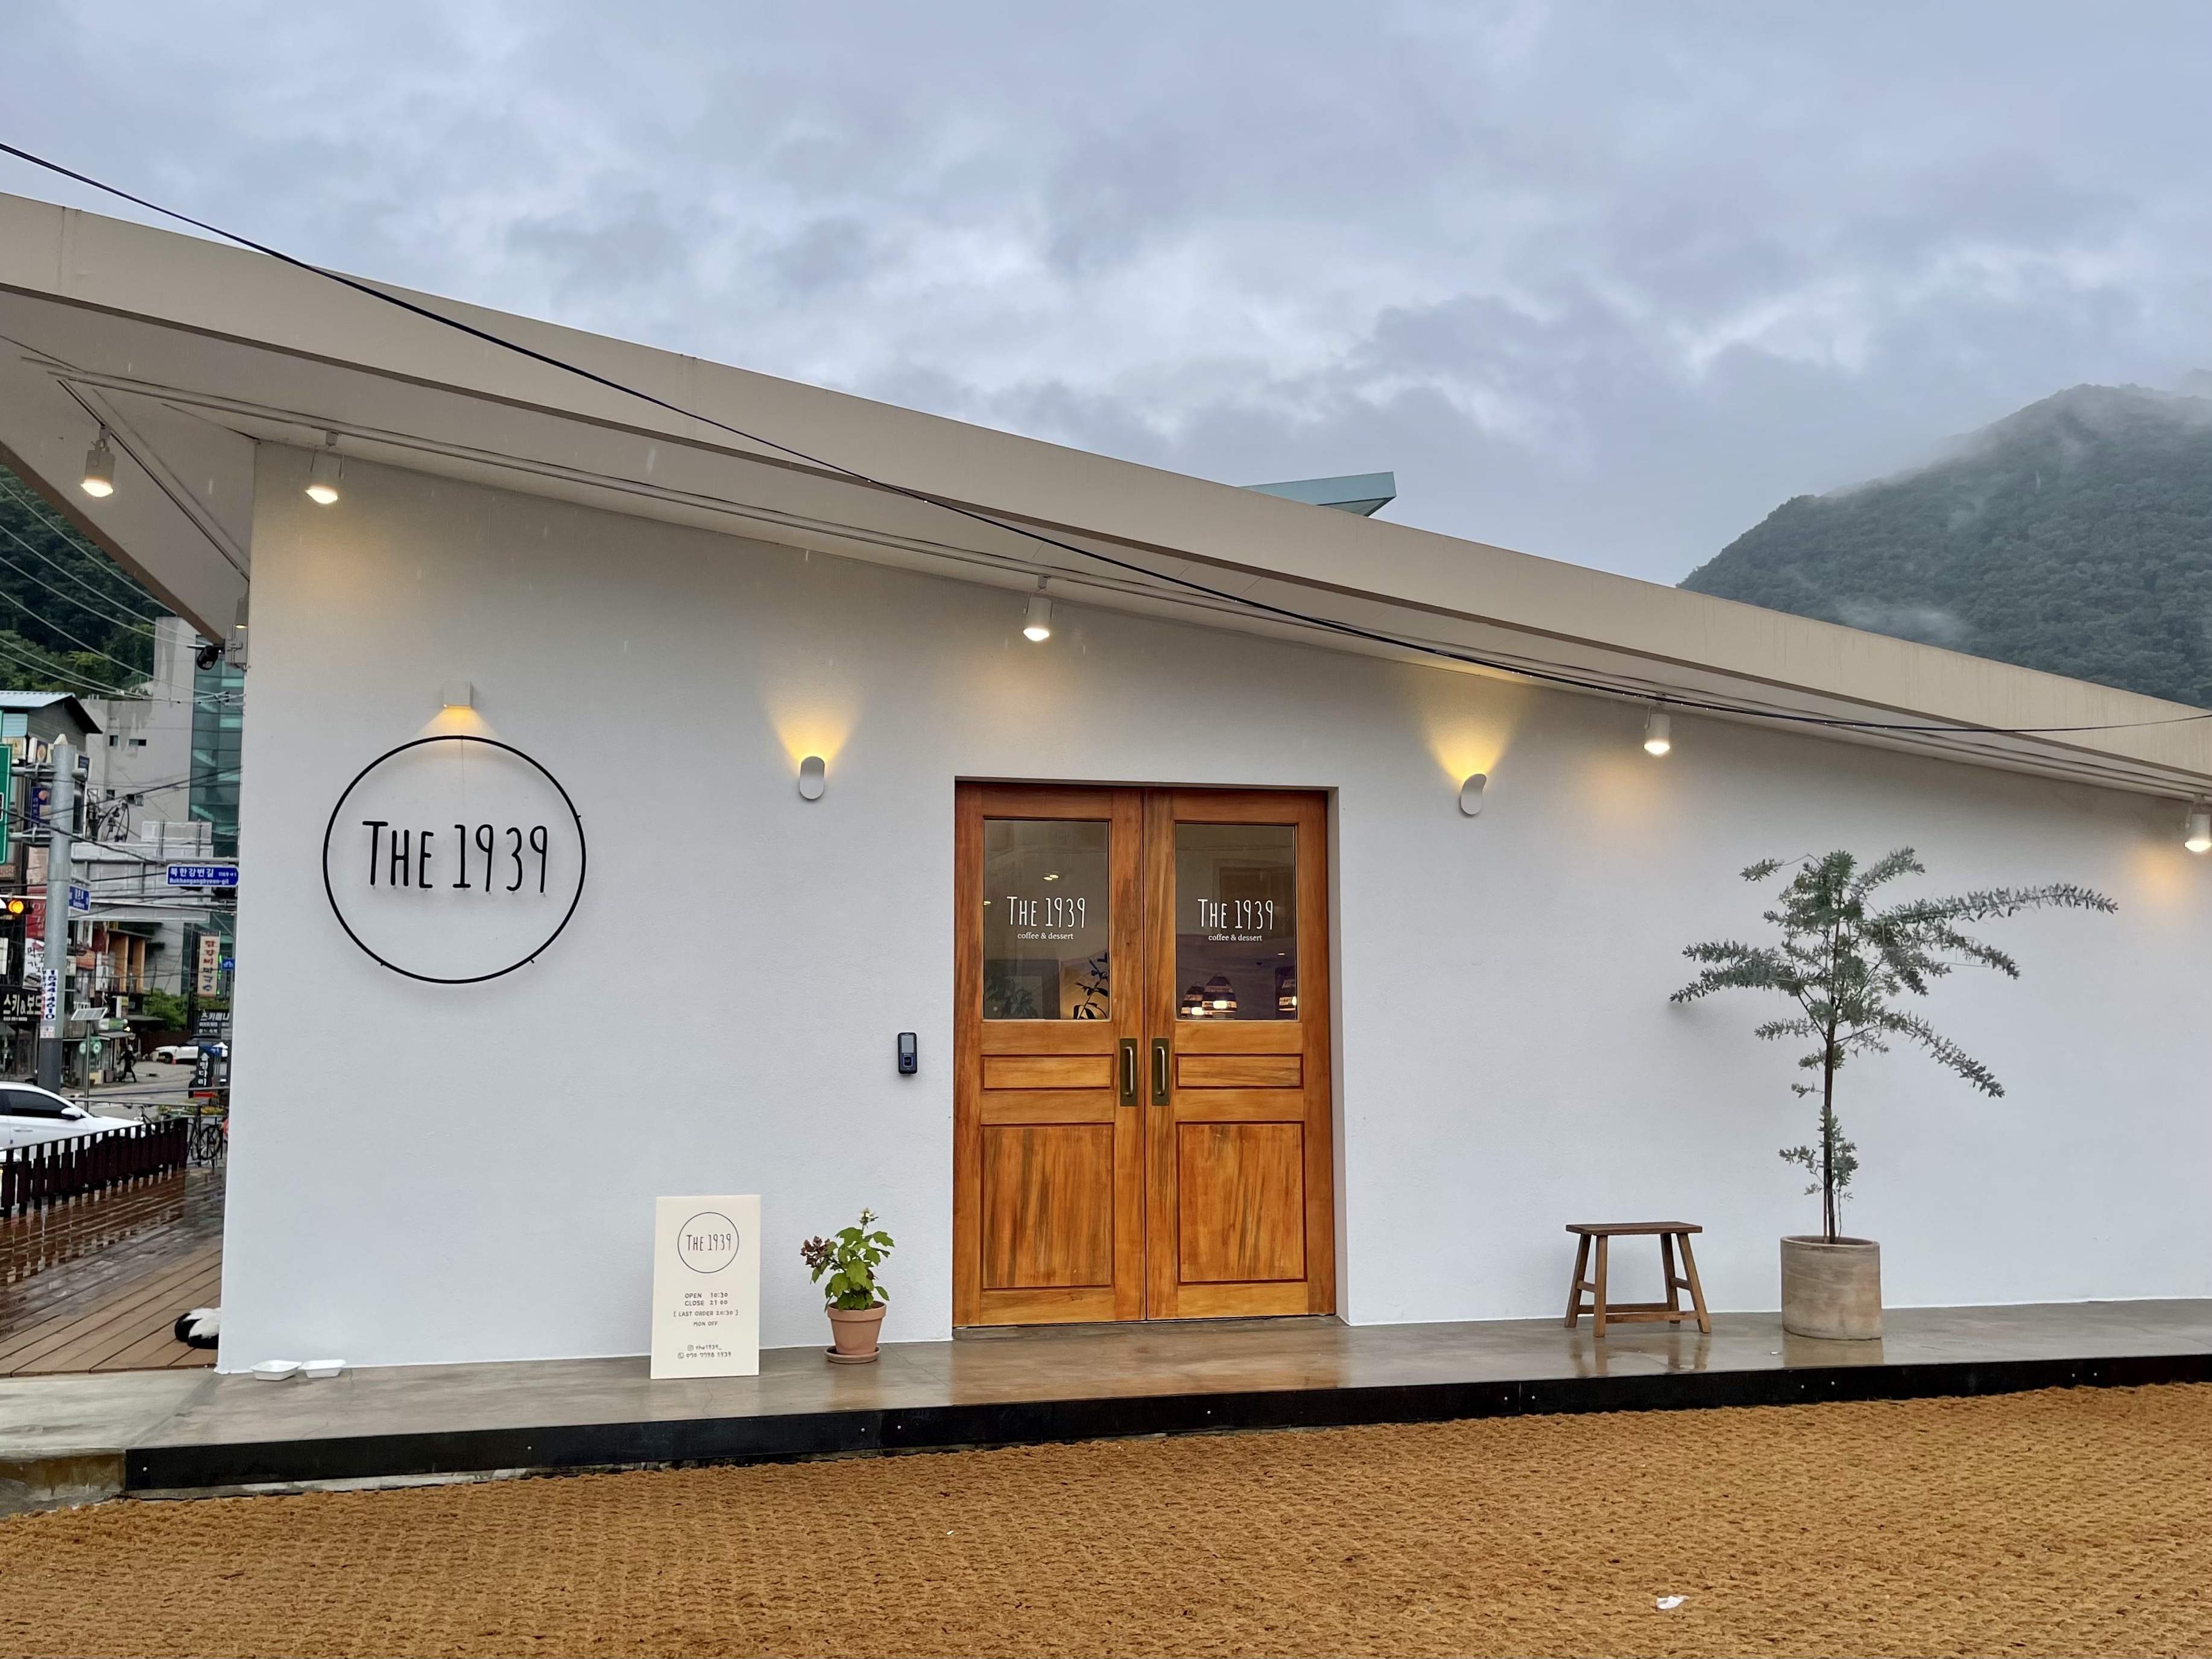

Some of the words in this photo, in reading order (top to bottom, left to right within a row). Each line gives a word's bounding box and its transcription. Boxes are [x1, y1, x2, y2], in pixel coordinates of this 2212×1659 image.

[362, 821, 434, 889] THE
[452, 824, 548, 893] 1939
[1006, 896, 1038, 927] THE
[1045, 897, 1085, 928] 1939
[1197, 899, 1227, 929] THE
[1234, 900, 1273, 930] 1939
[1208, 933, 1229, 941] coffee
[686, 1234, 704, 1251] THE
[708, 1233, 731, 1251] 1939
